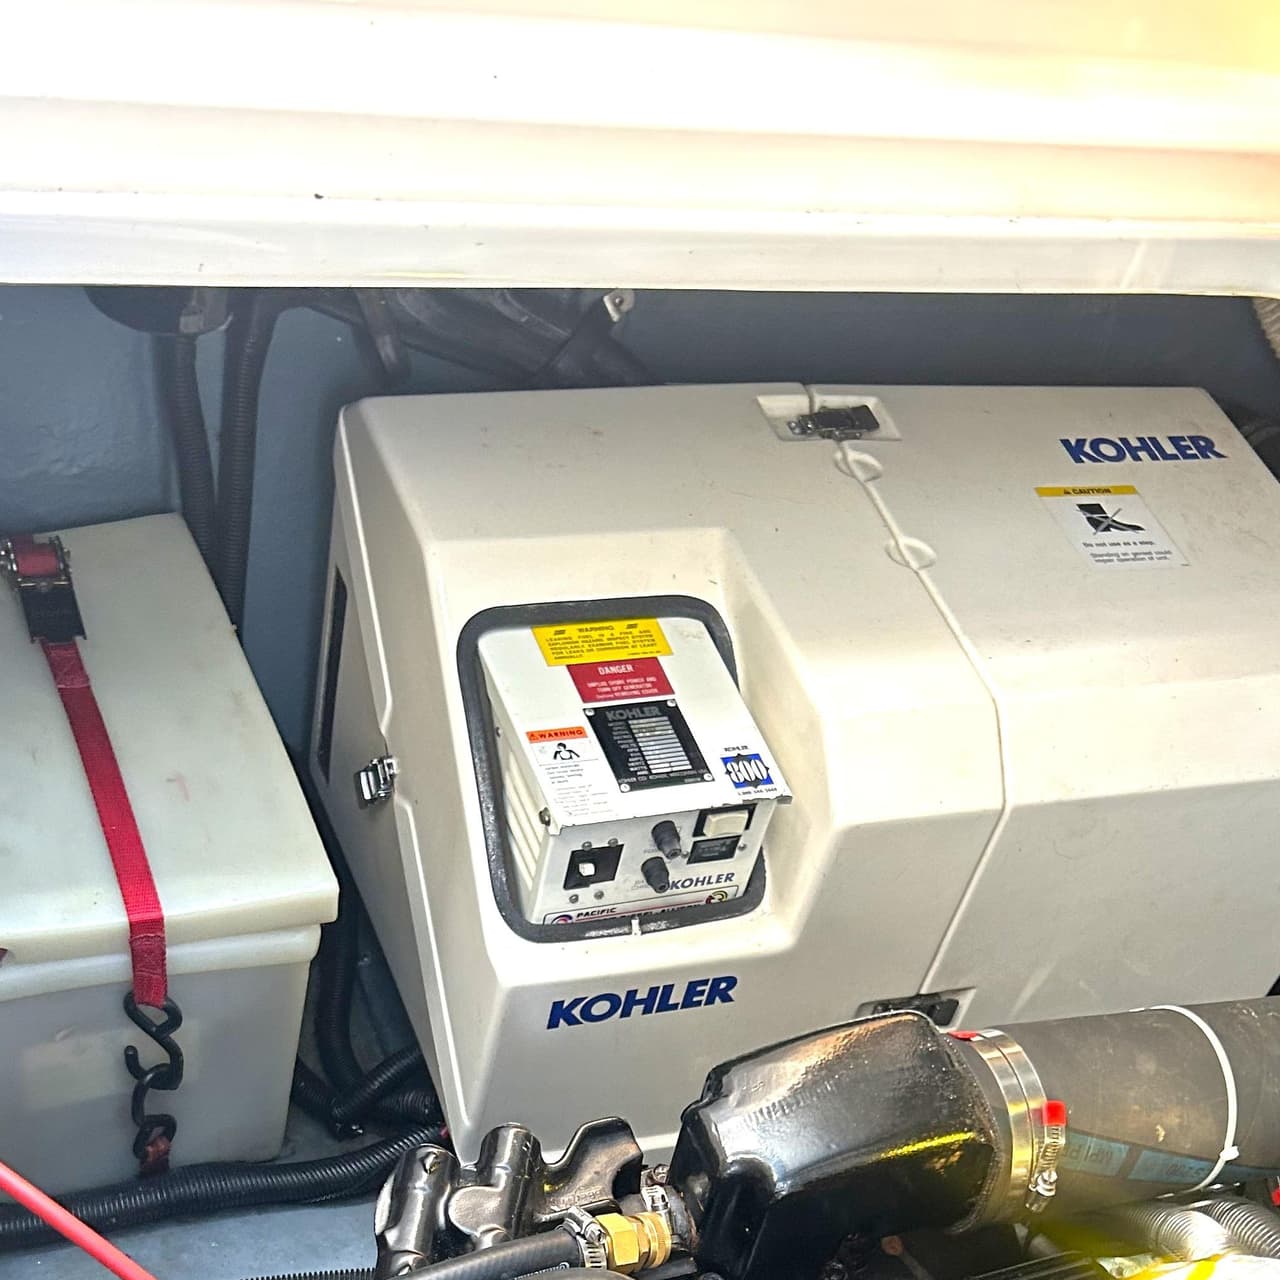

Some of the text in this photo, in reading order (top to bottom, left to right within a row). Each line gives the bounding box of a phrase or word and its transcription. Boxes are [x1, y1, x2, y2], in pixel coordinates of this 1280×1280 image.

[1060, 435, 1229, 463] KOHLER
[1072, 487, 1112, 495] CAUTION
[598, 664, 634, 675] DANGER
[605, 706, 662, 720] KOHLER
[539, 730, 583, 738] WARNING
[727, 759, 768, 783] 800
[669, 872, 735, 890] KOHLER
[576, 907, 617, 917] PACIFIC
[546, 975, 738, 1030] KOHLER
